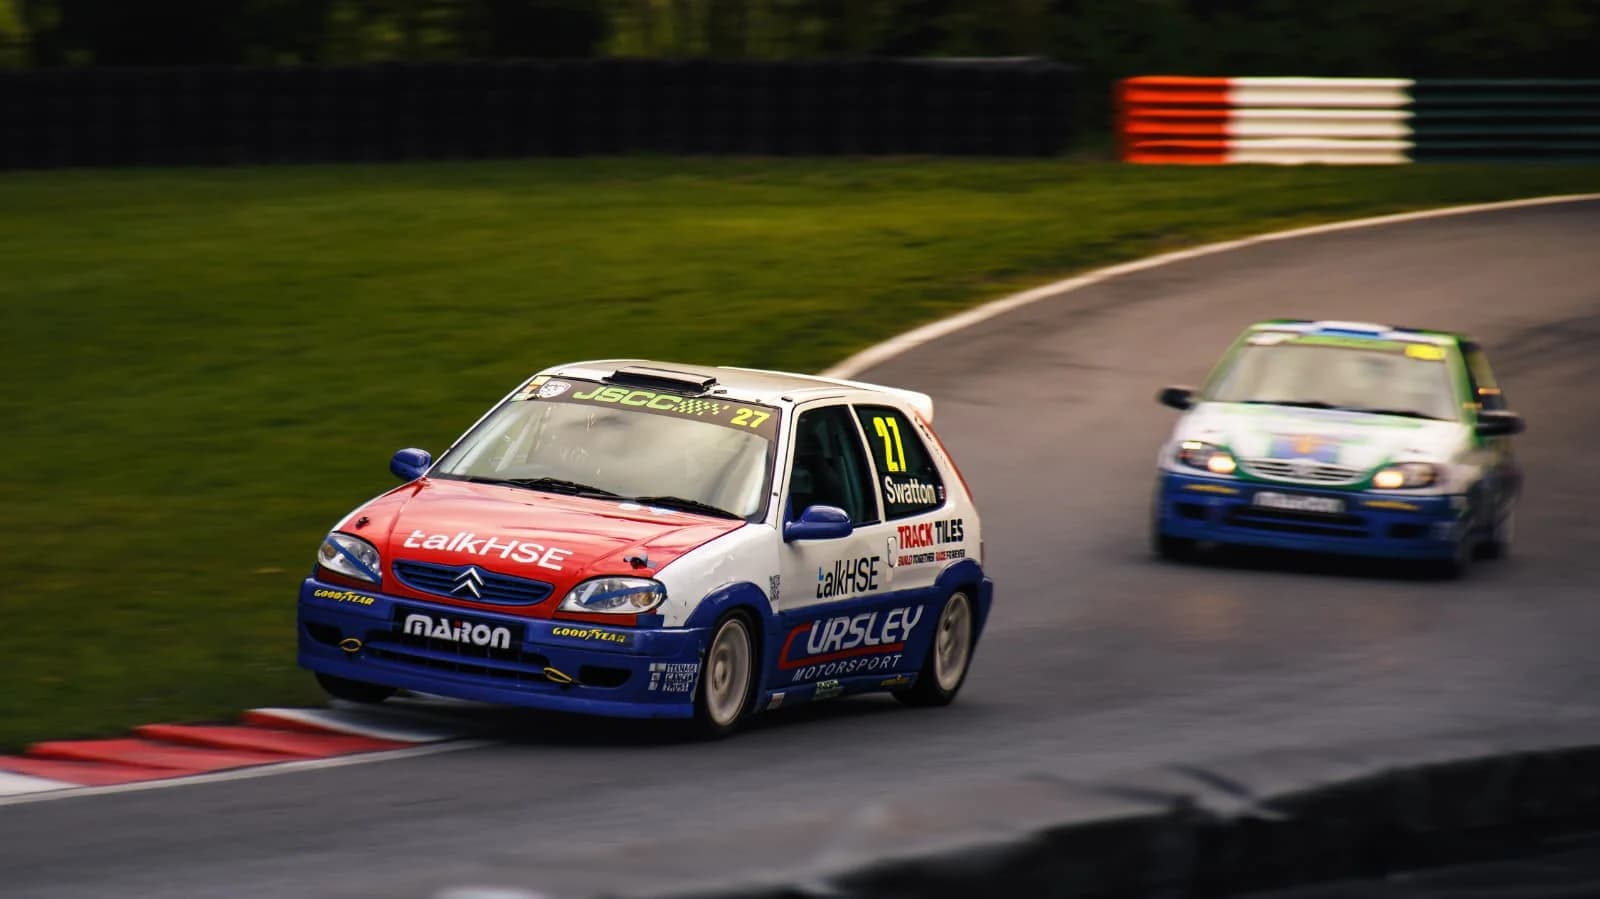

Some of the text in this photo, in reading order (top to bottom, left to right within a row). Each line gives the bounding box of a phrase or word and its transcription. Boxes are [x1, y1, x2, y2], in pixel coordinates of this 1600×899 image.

[572, 386, 682, 410] JSCC
[731, 408, 770, 428] 27
[873, 417, 906, 472] 27
[885, 476, 936, 504] Swatton
[403, 530, 573, 571] talkHSE
[898, 519, 964, 549] TRACK TILES
[816, 555, 880, 599] talkHSE
[792, 655, 902, 682] MOTORSPORT
